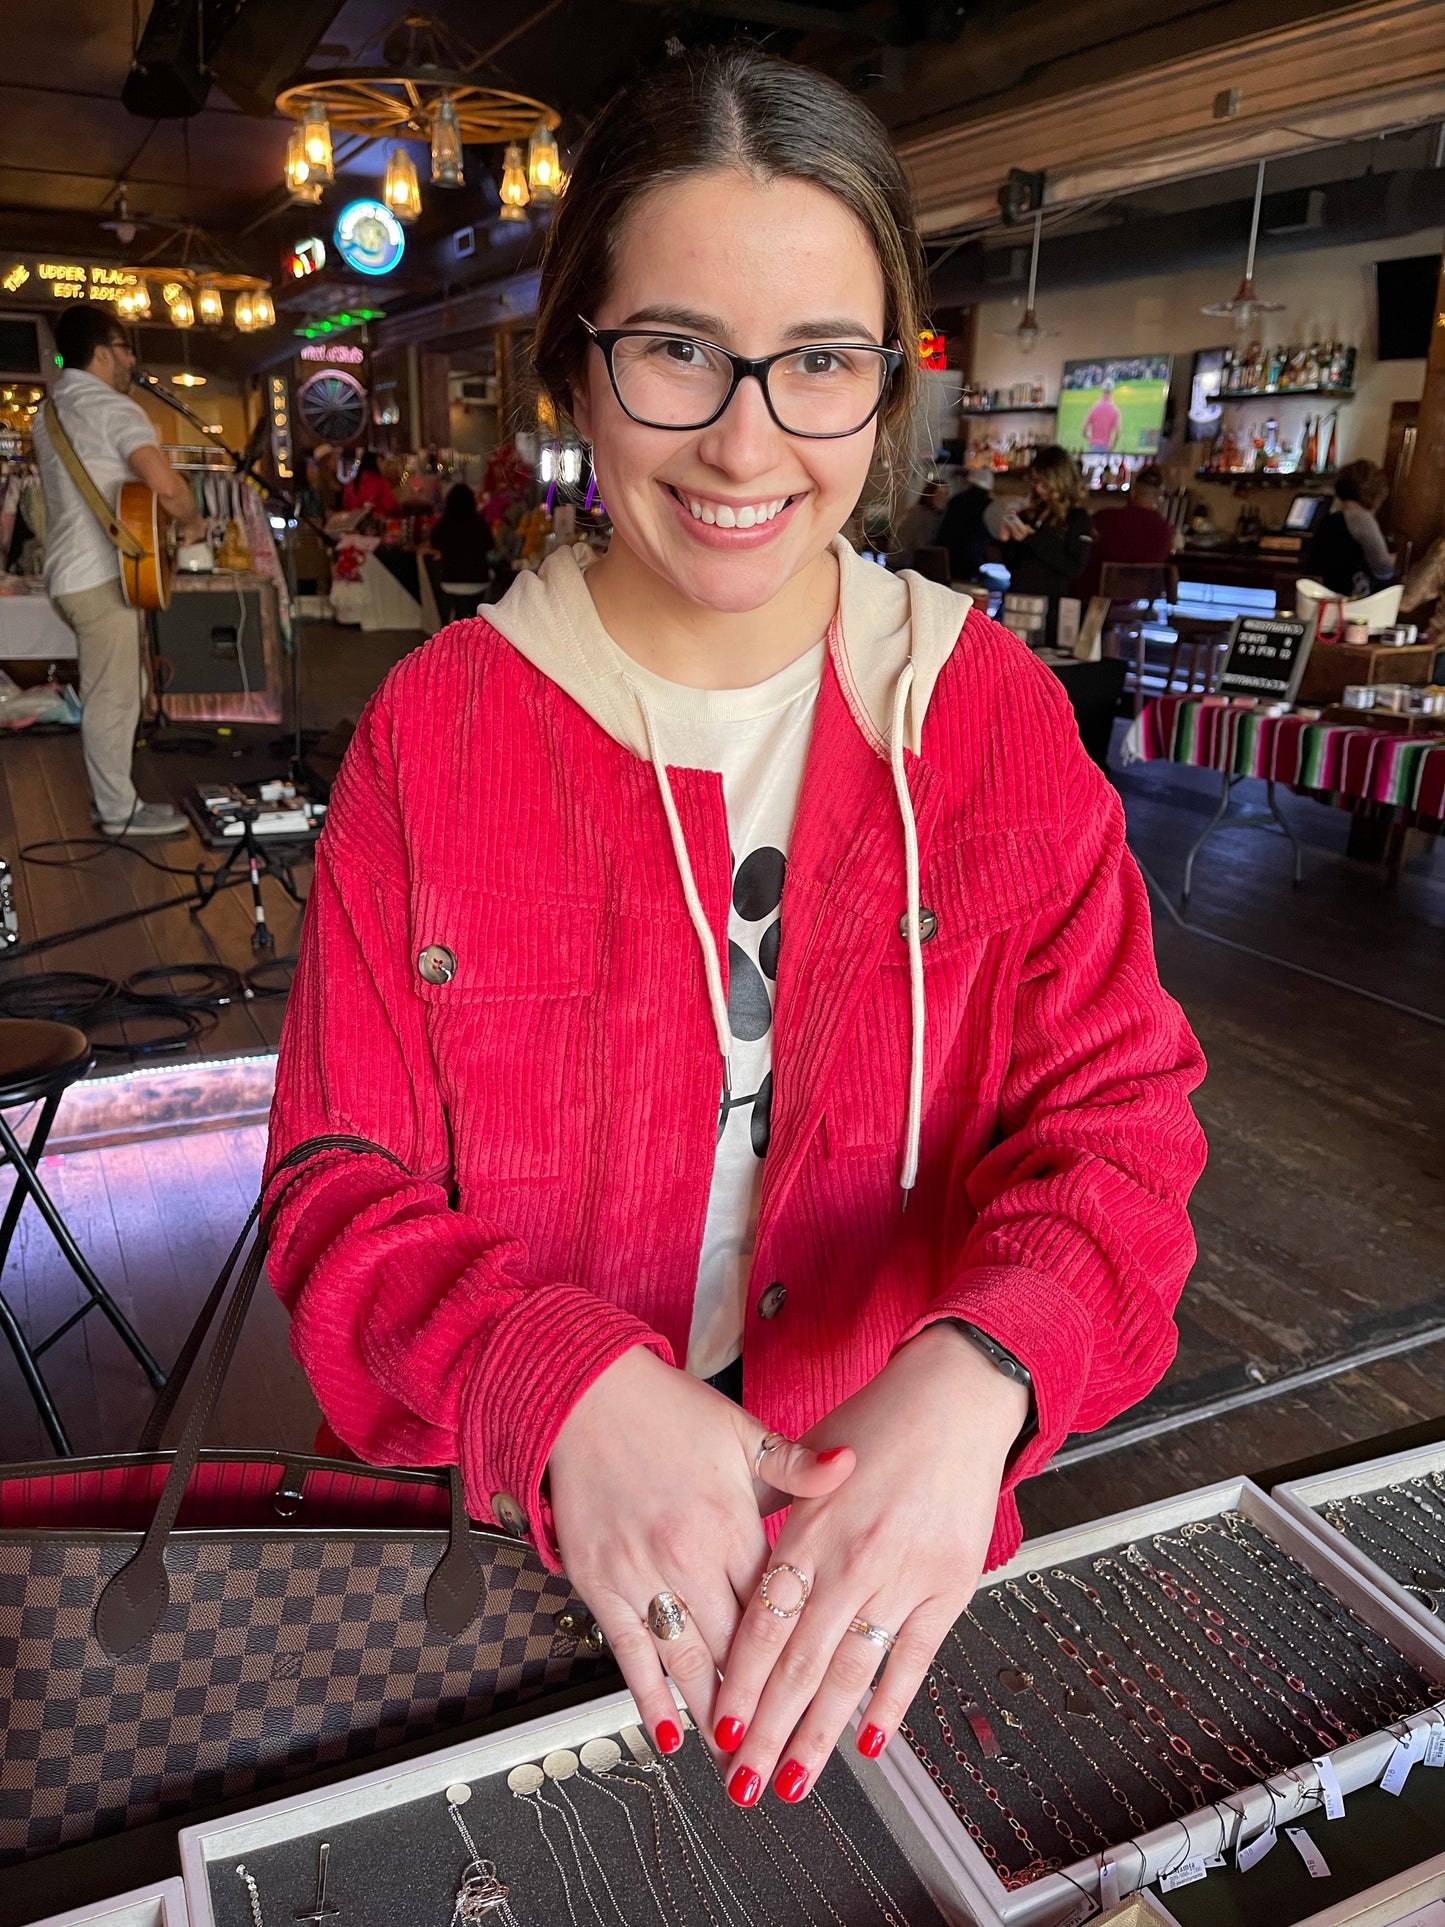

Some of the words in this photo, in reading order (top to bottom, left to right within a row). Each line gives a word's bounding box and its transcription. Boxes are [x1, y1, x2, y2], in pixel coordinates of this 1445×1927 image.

[3, 265, 30, 292] THE
[39, 263, 87, 283] UDDER
[53, 282, 85, 298] EST.
